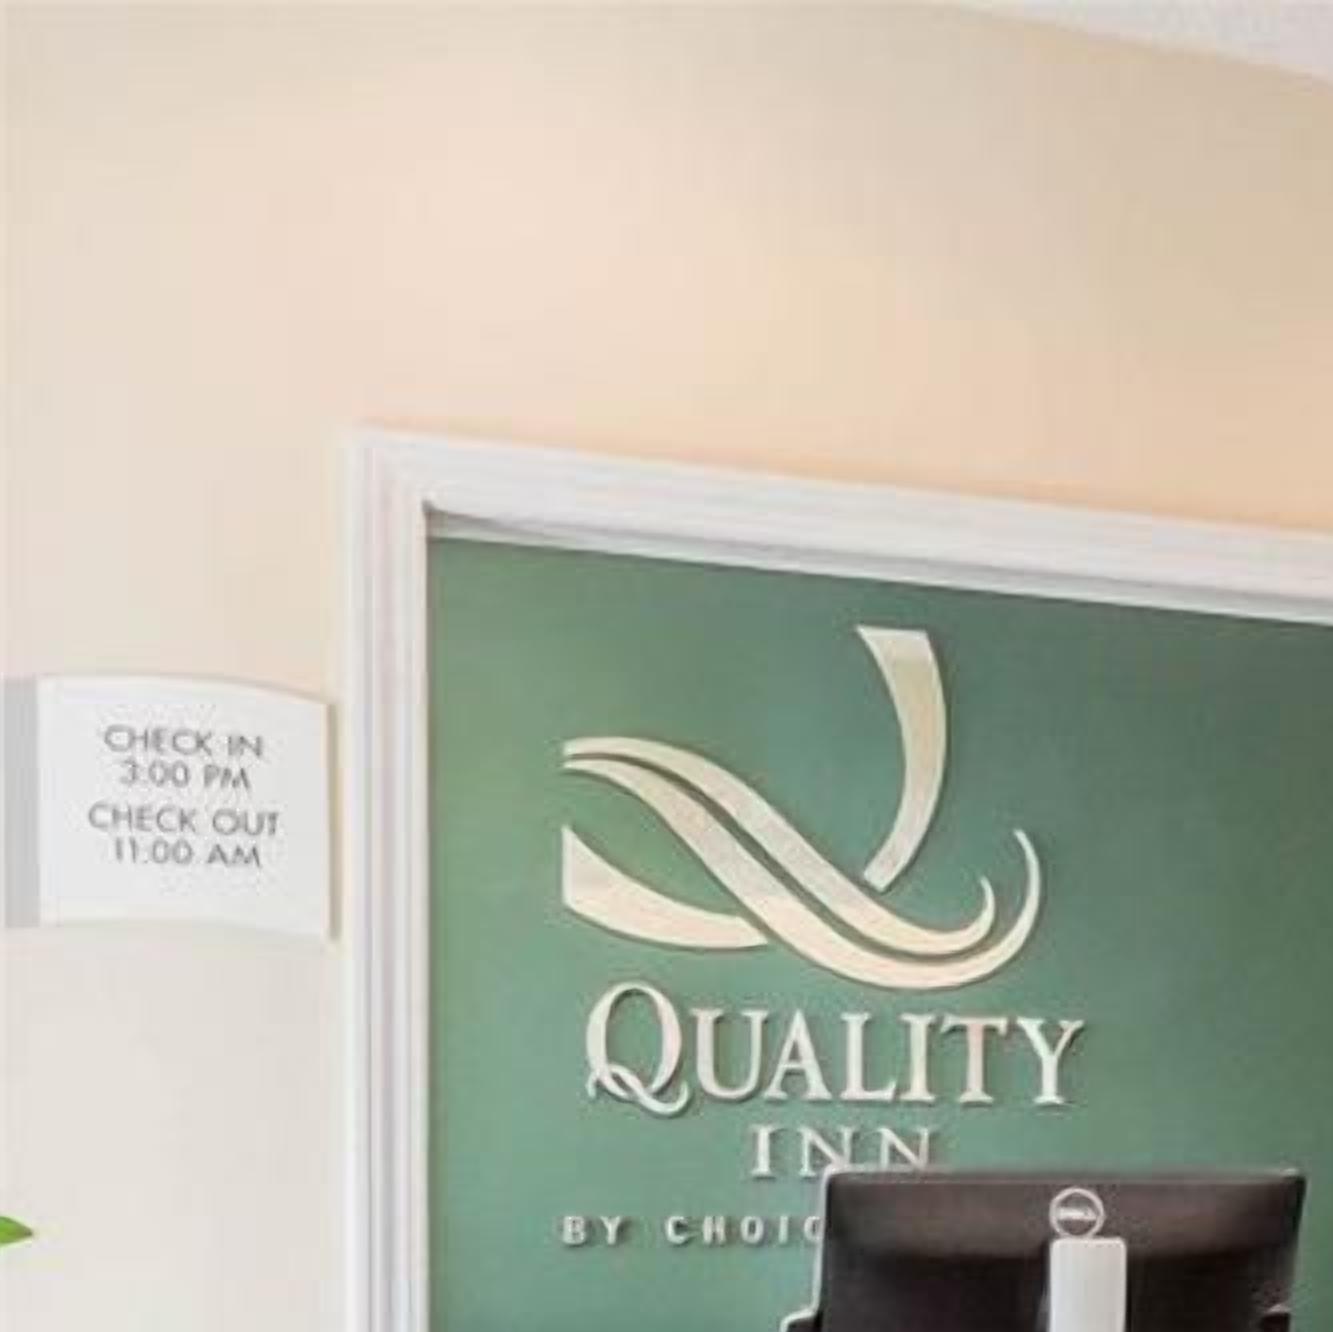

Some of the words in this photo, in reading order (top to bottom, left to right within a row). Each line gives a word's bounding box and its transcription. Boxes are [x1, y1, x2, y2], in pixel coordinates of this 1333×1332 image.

[104, 724, 212, 756] CHECK
[227, 734, 264, 757] IN
[203, 763, 251, 791] PM
[88, 801, 197, 834] CHECK
[212, 806, 280, 836] OUT
[206, 842, 261, 868] AM
[585, 979, 1085, 1117] QUALITY
[750, 1124, 940, 1175] INN
[562, 1214, 622, 1245] BY
[664, 1214, 827, 1245] CHOIC
